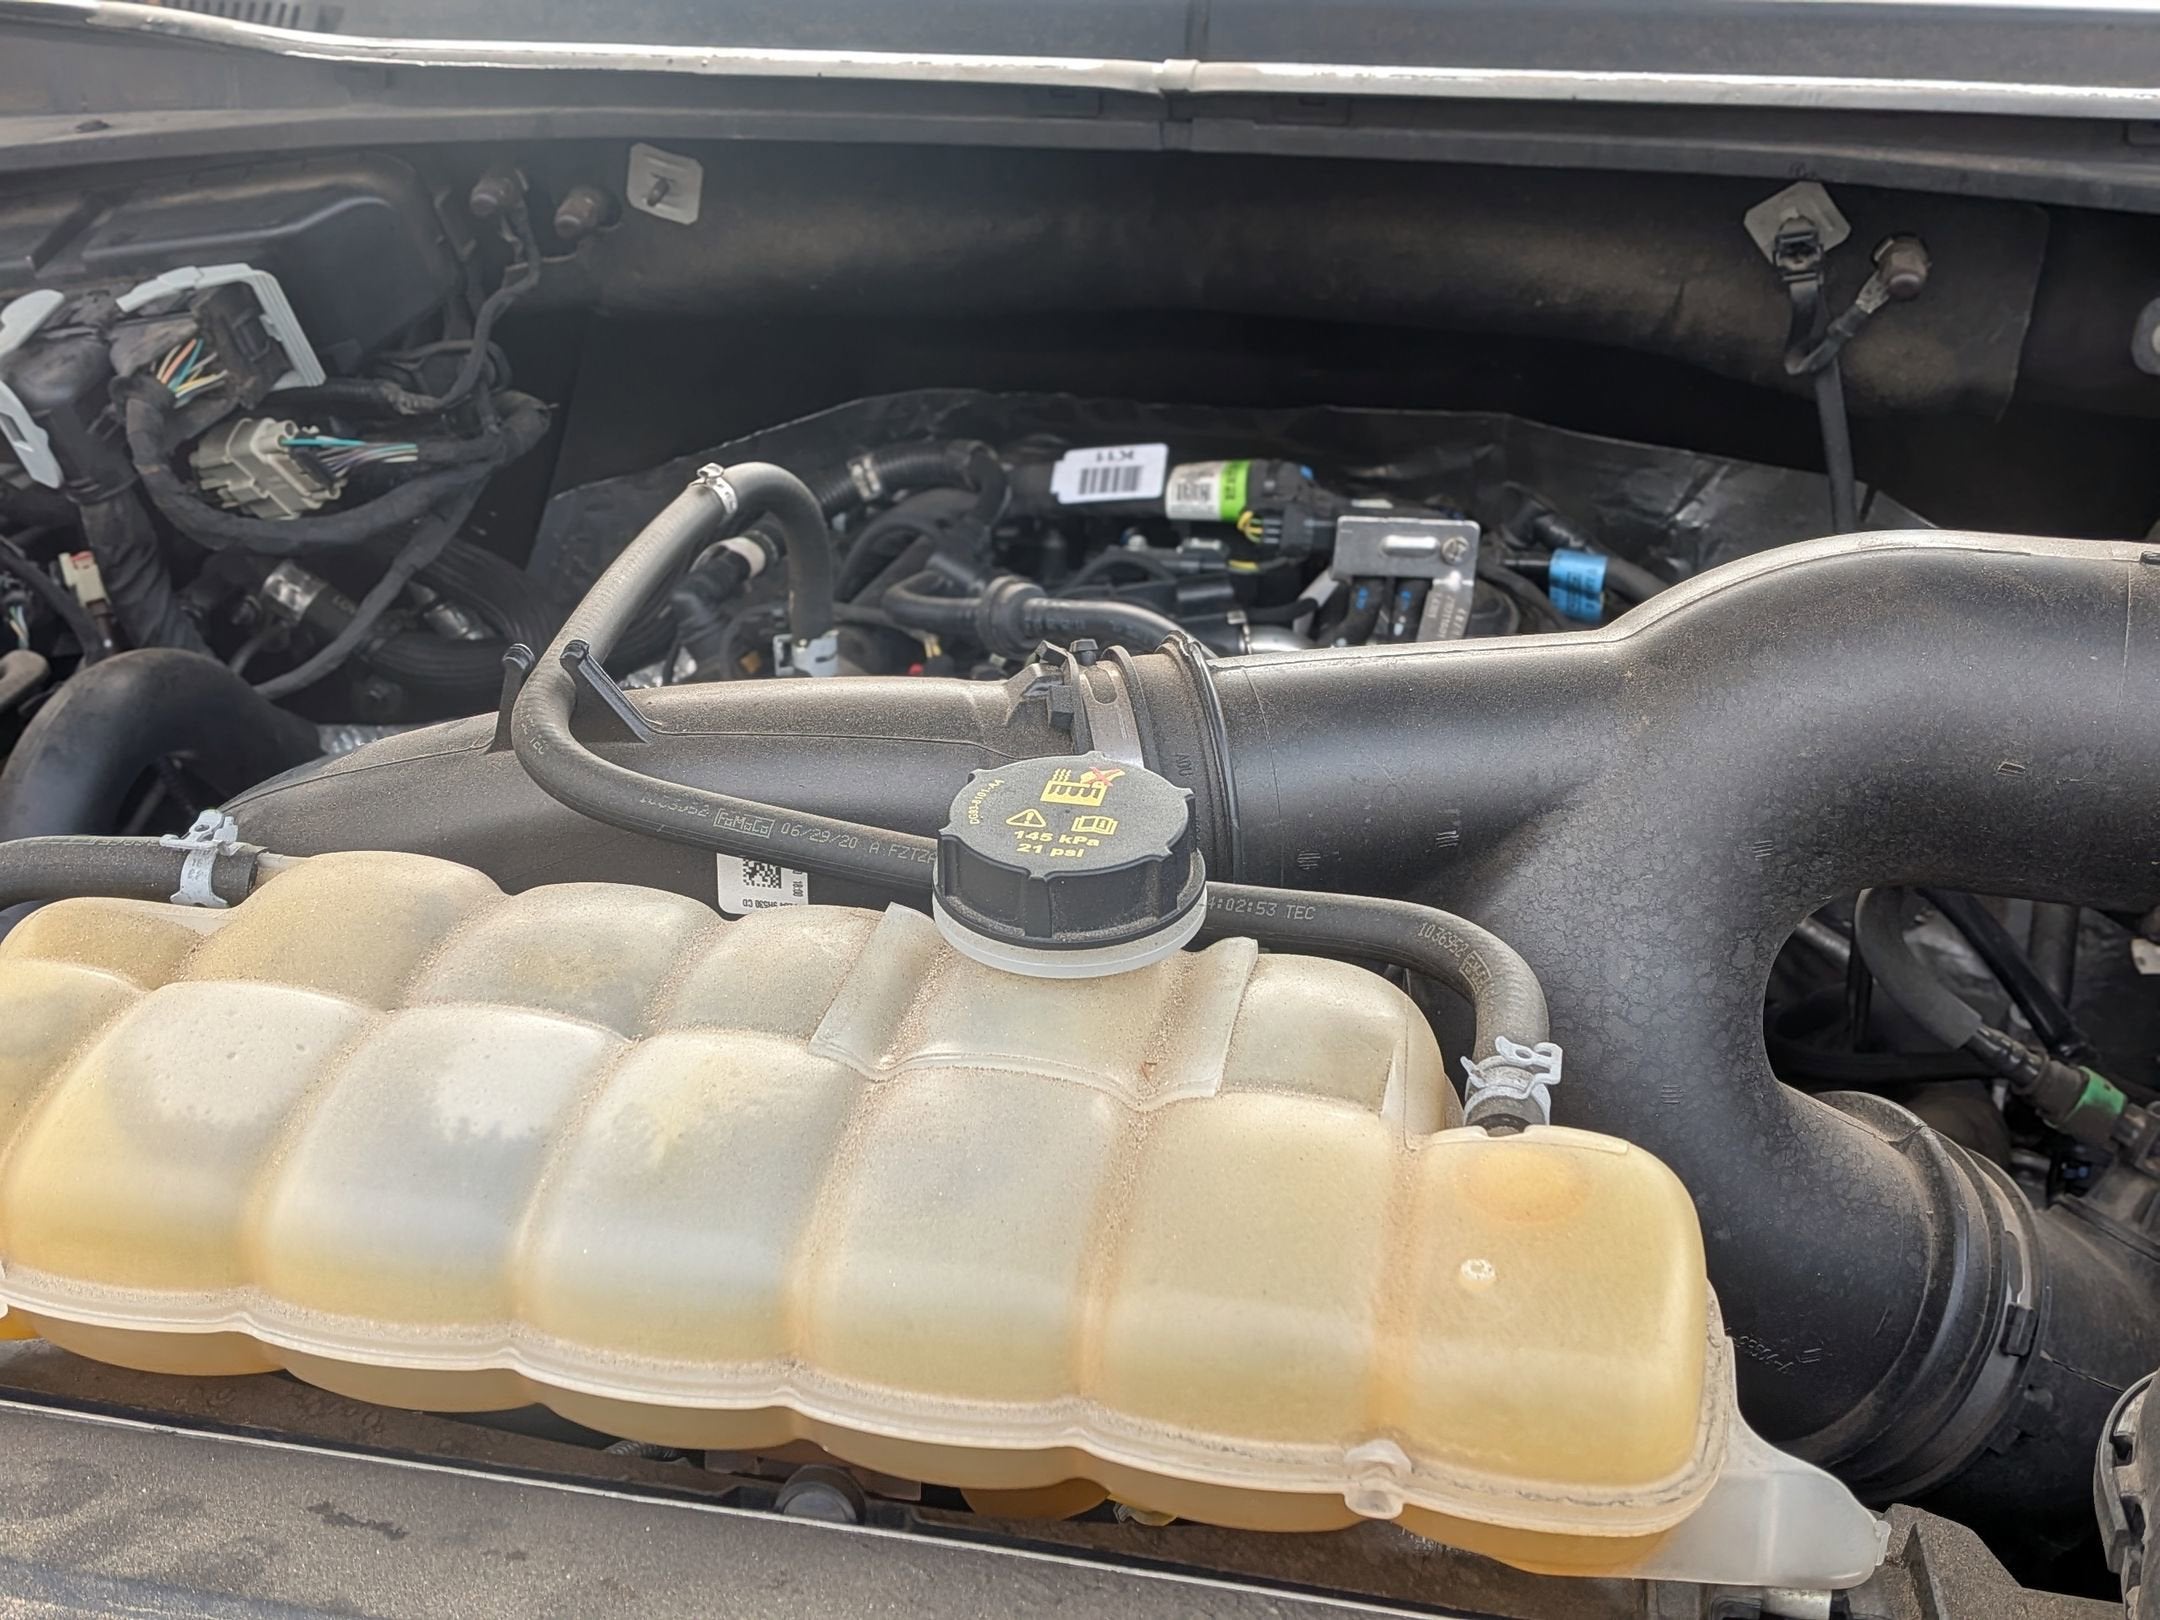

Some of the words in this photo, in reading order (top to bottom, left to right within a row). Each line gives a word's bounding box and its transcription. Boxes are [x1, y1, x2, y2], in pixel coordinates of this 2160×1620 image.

[716, 809, 772, 837] FoMoCo
[780, 822, 858, 849] 06/29/20
[1013, 829, 1054, 843] 145
[1058, 833, 1100, 848] kPa
[1016, 843, 1044, 855] 21
[1049, 845, 1085, 858] psi
[1285, 905, 1317, 921] TEC
